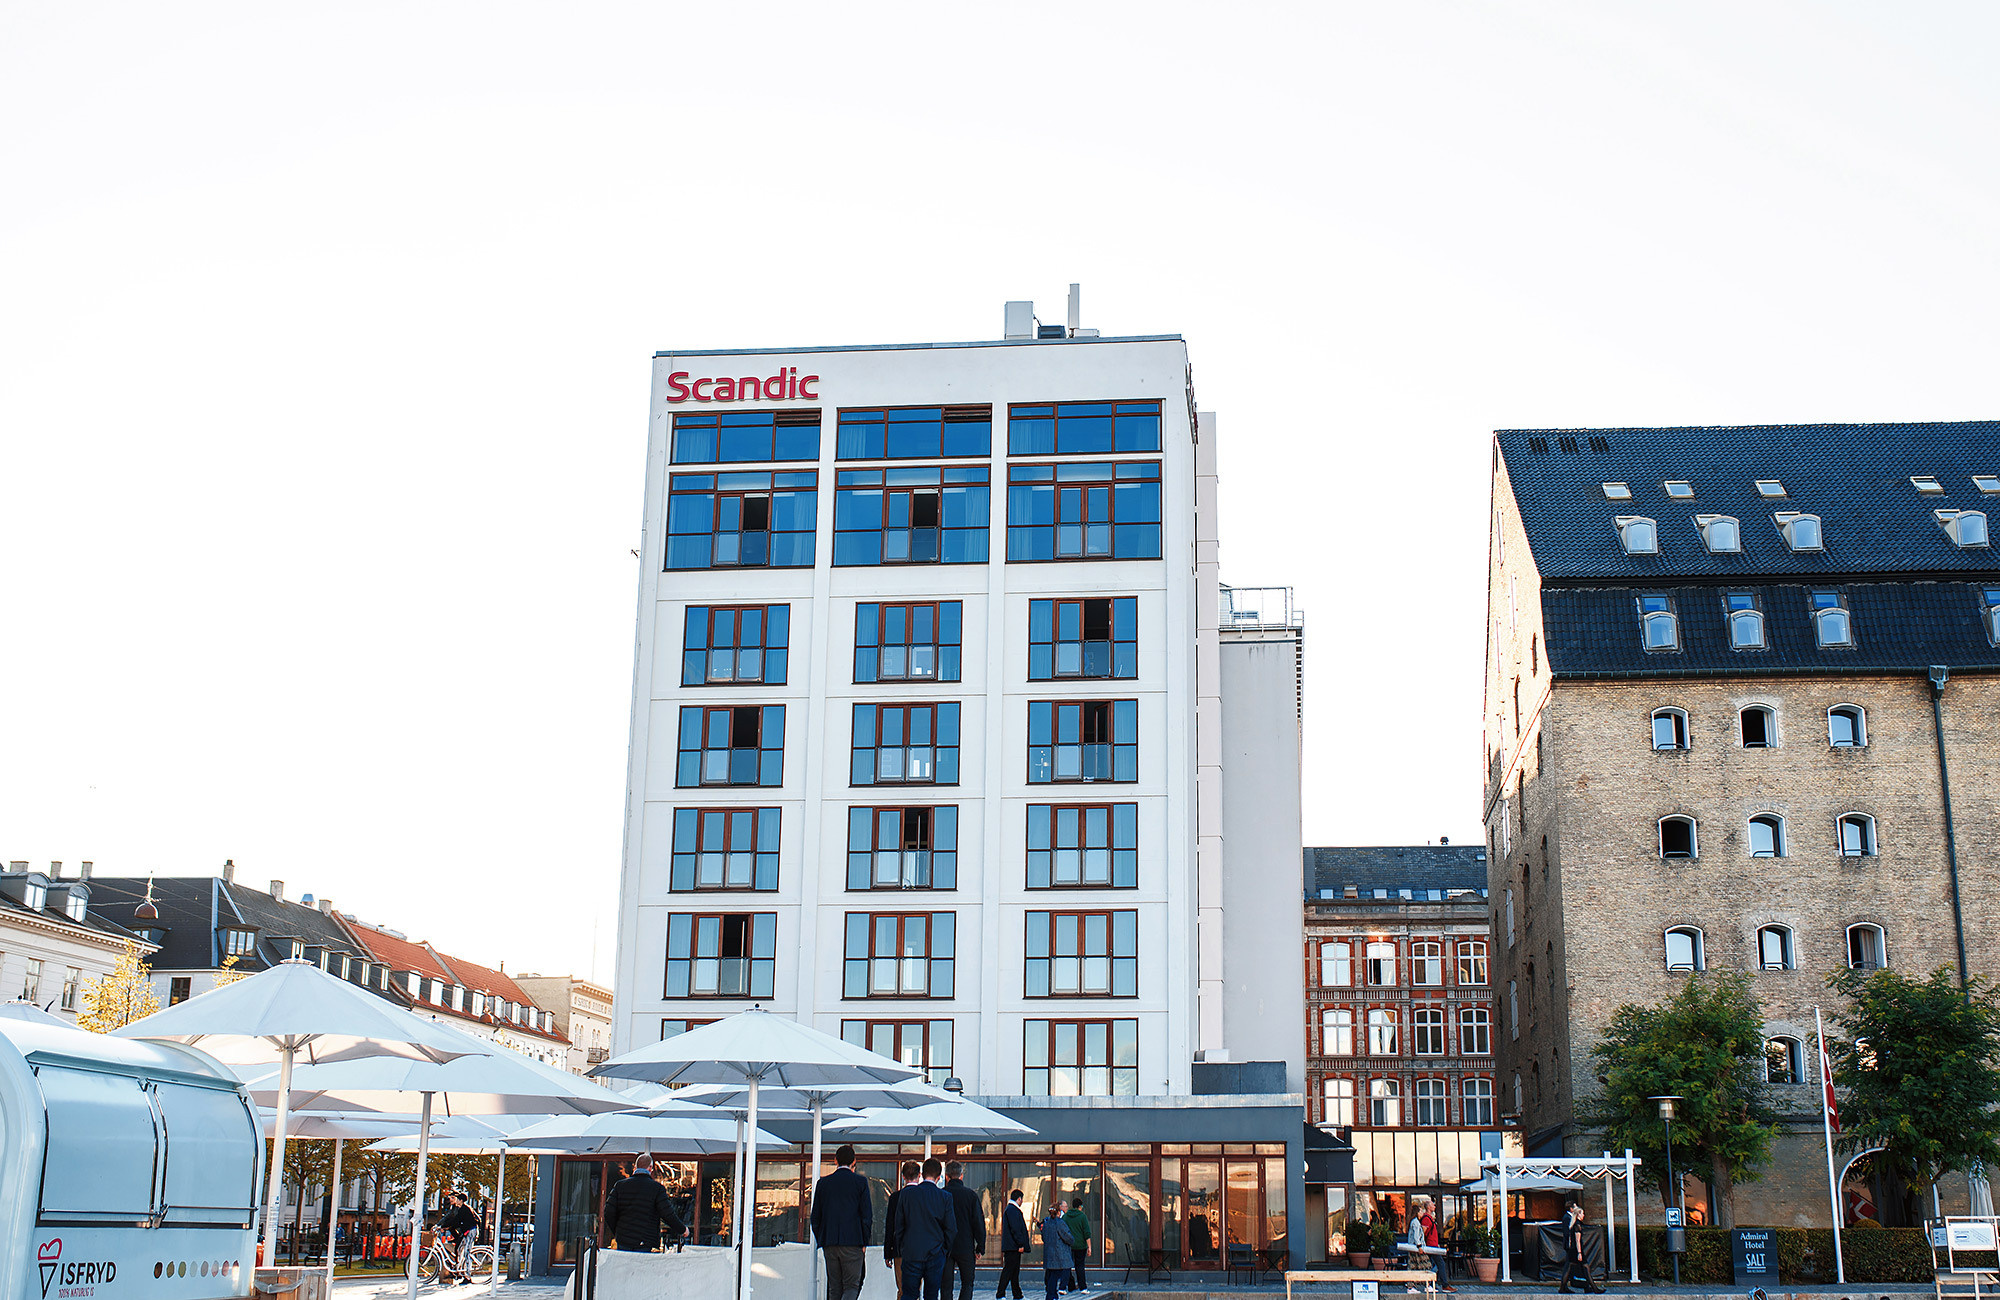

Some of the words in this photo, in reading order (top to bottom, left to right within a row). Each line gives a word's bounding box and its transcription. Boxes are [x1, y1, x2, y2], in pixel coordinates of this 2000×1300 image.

[666, 366, 820, 402] Scandic
[1740, 1231, 1769, 1240] Admiral
[1744, 1241, 1765, 1249] Hotel
[1745, 1253, 1766, 1267] SALT
[59, 1261, 117, 1286] ISFRYD
